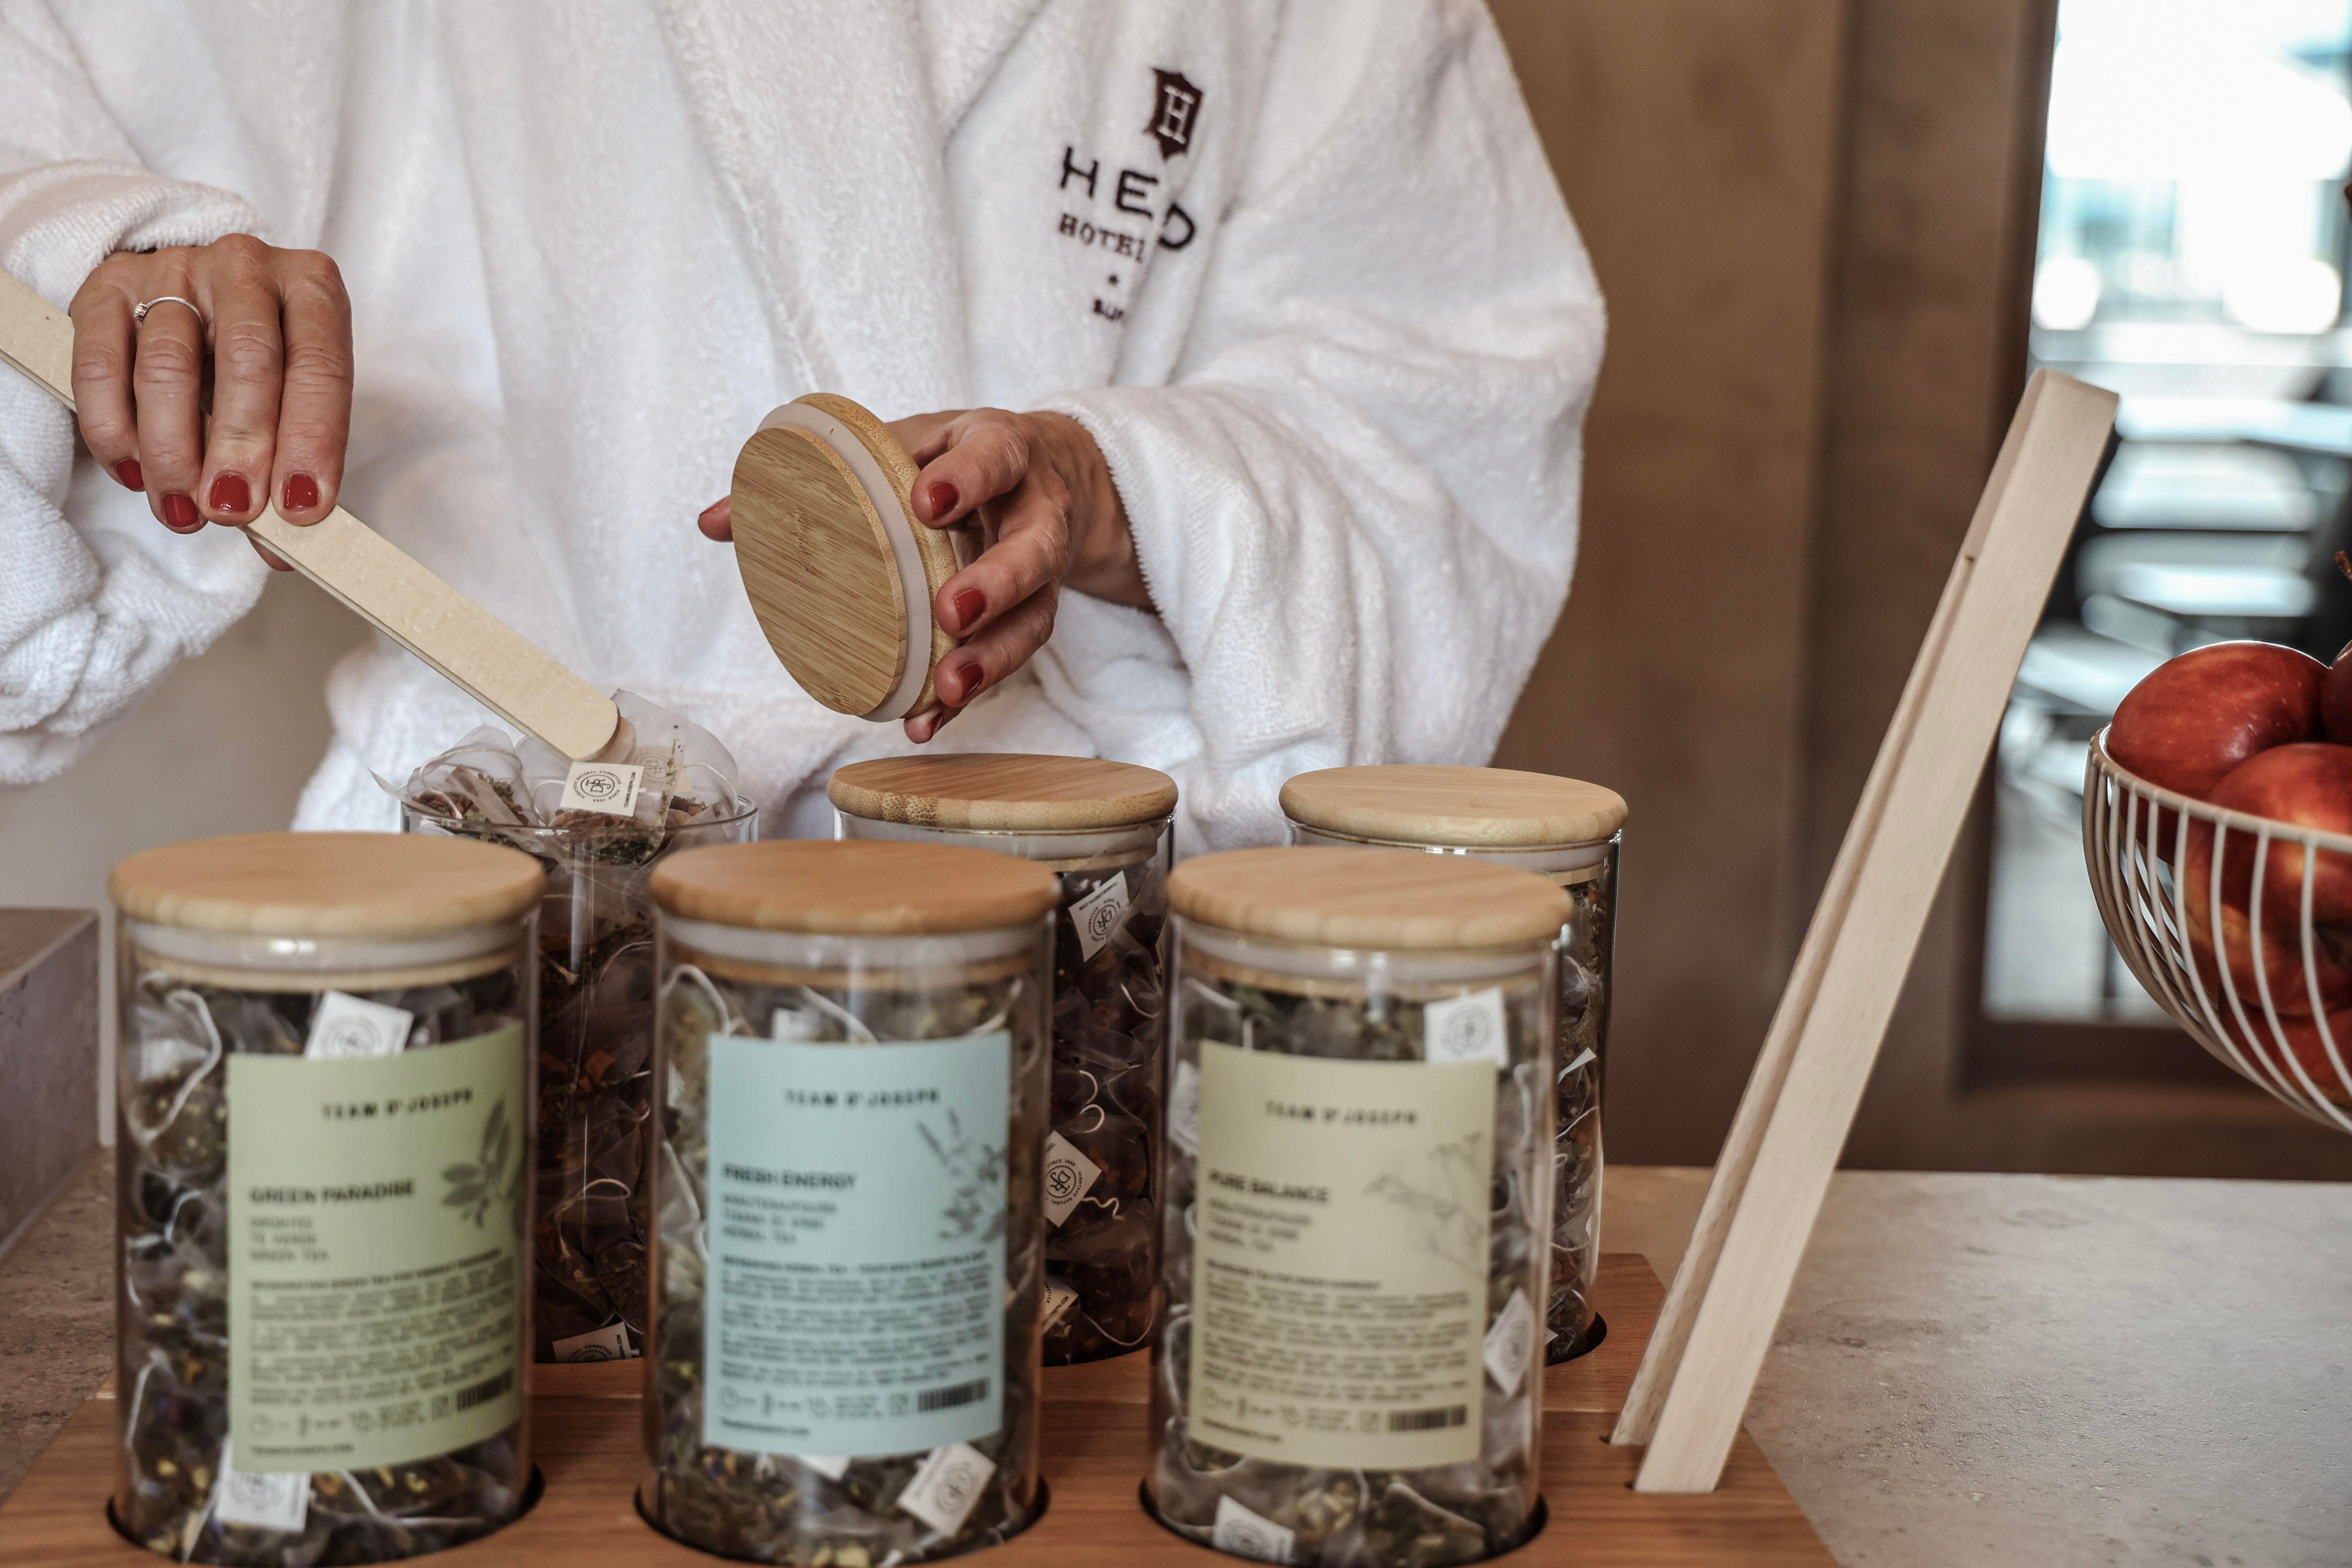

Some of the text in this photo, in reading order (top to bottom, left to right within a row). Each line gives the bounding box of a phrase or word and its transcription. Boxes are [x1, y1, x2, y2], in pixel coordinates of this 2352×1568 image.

[721, 1164, 857, 1190] FRESH ENERGY
[1209, 1169, 1330, 1204] PURE BALANCE
[248, 1178, 416, 1204] GREEN PARADISE
